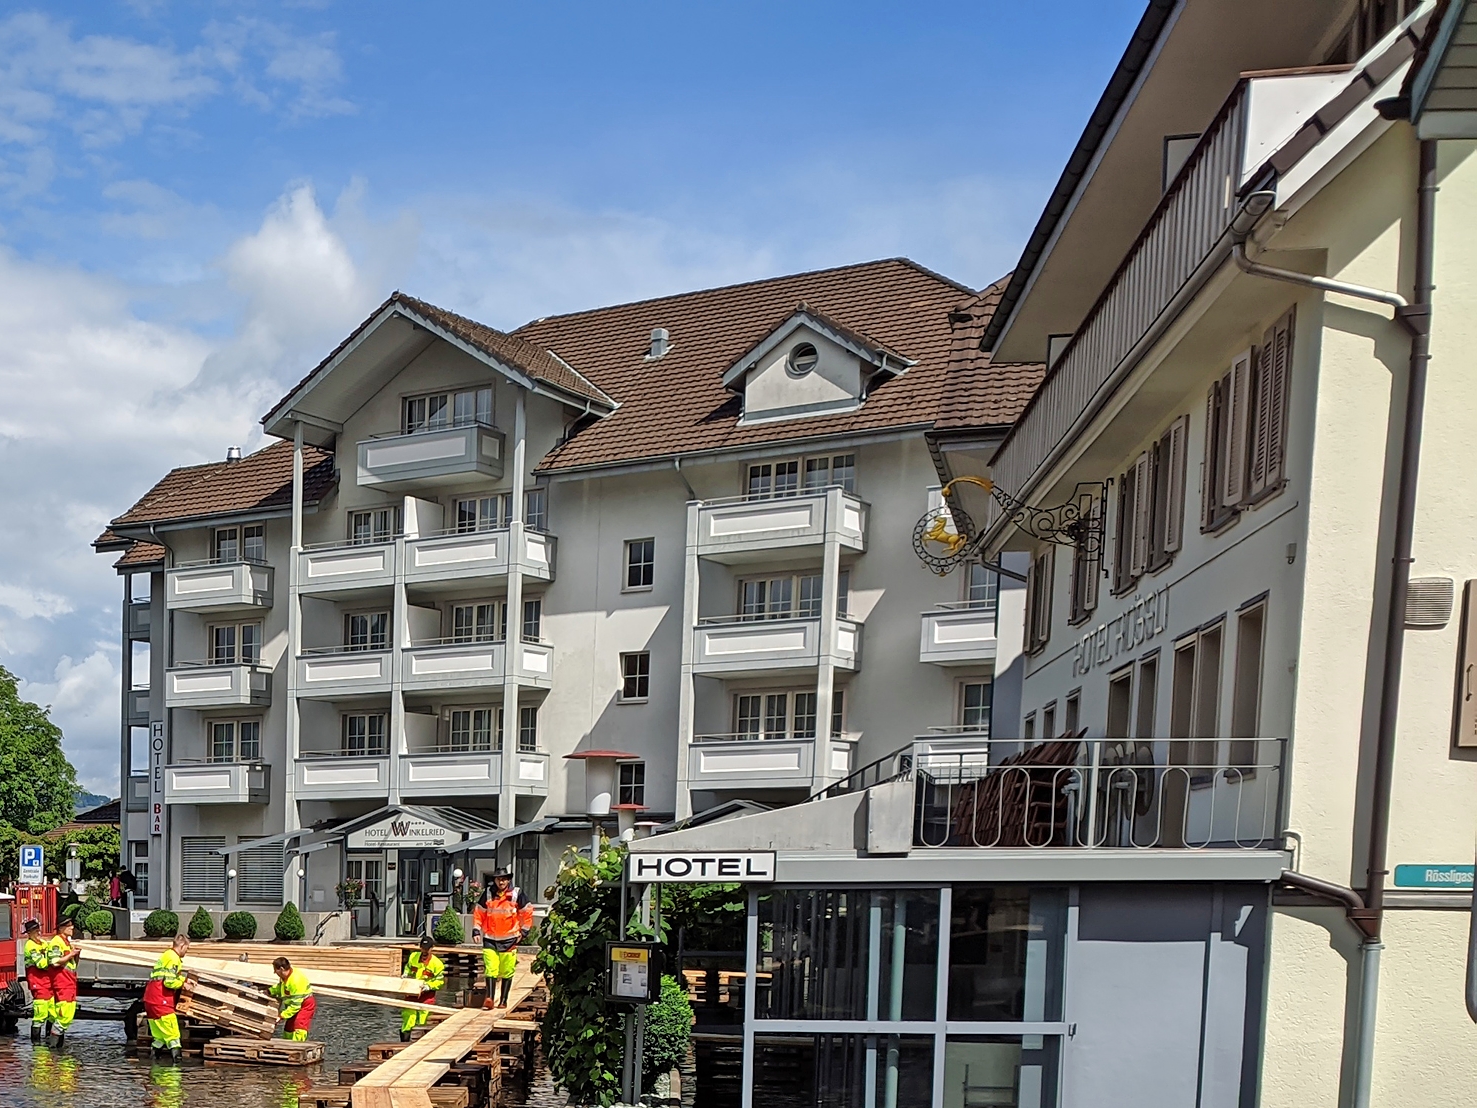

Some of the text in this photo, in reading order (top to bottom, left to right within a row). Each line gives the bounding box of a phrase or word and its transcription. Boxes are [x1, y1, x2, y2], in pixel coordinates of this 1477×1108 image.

[153, 724, 164, 832] HOTEL BAR
[364, 821, 446, 837] HOTEL WINKELRIED
[24, 848, 36, 865] P
[637, 857, 768, 877] HOTEL
[1425, 869, 1475, 885] Rössligas
